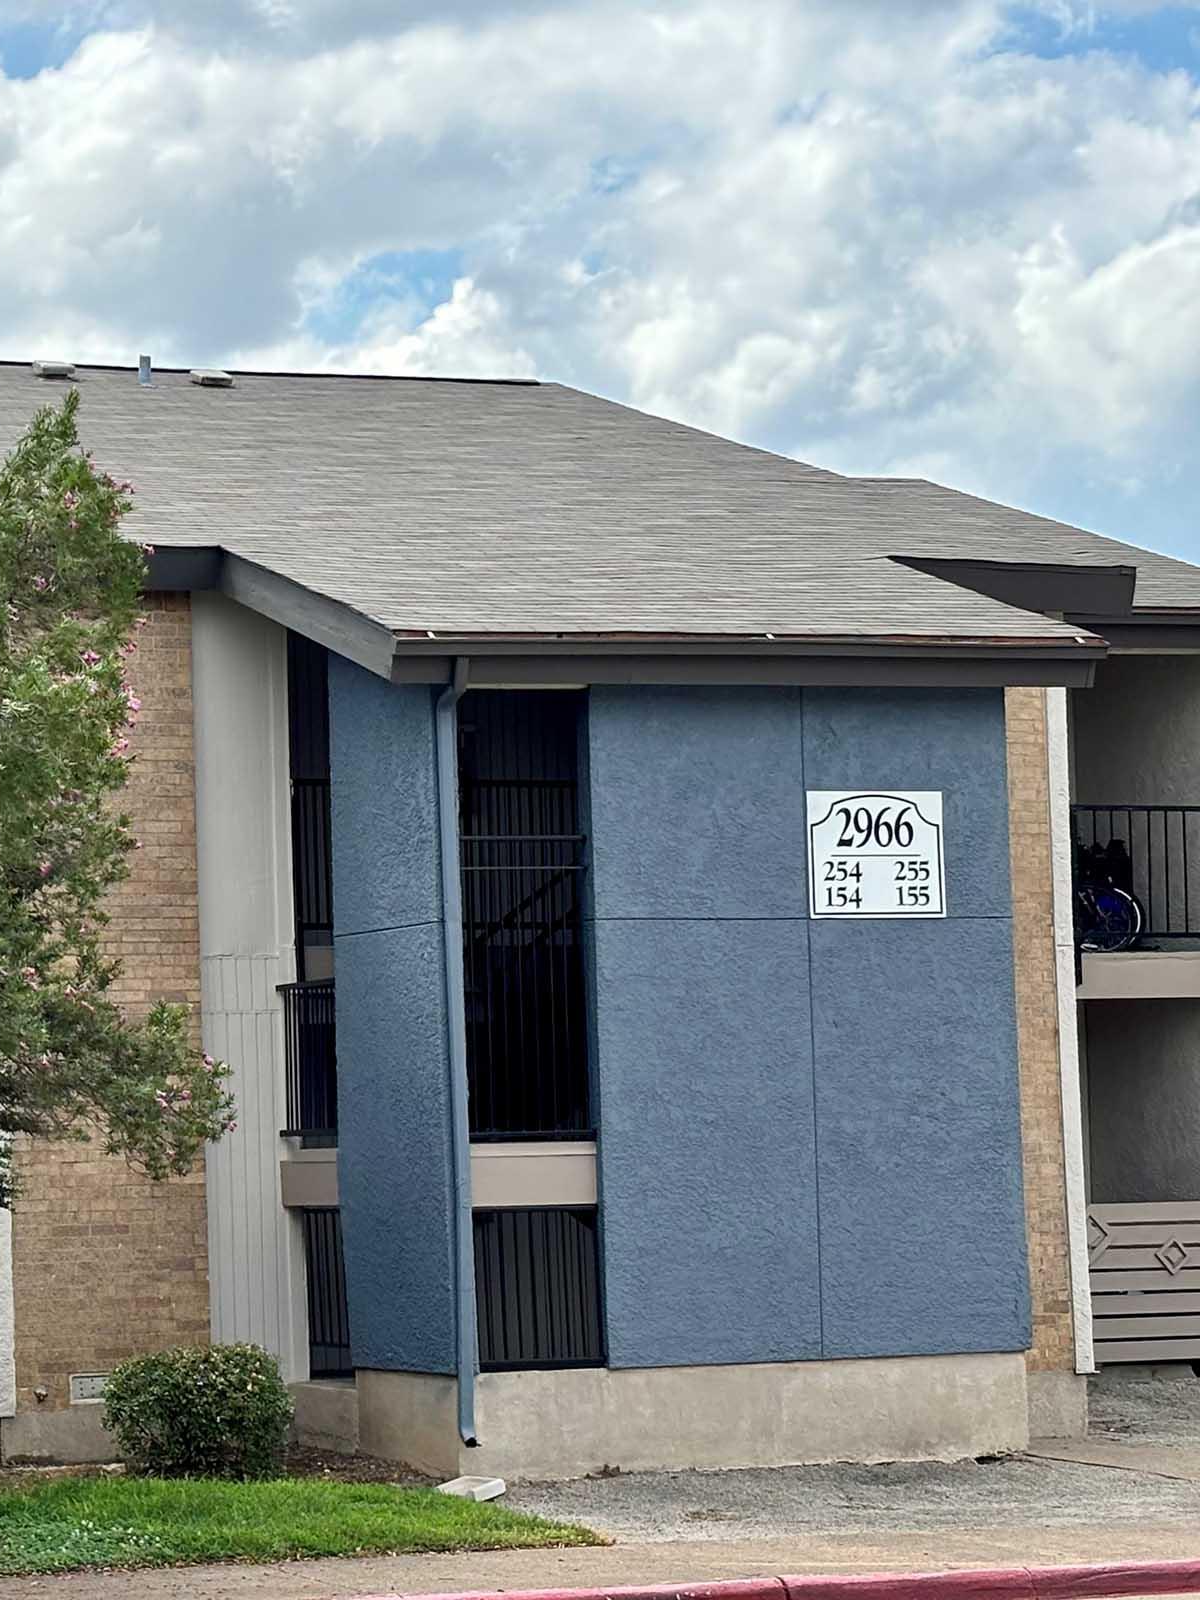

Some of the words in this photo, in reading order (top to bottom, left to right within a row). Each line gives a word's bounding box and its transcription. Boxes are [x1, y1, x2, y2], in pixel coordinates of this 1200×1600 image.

[835, 807, 914, 849] 2966
[823, 860, 863, 884] 254
[893, 859, 931, 882] 255
[825, 885, 863, 909] 154
[896, 884, 931, 907] 155
